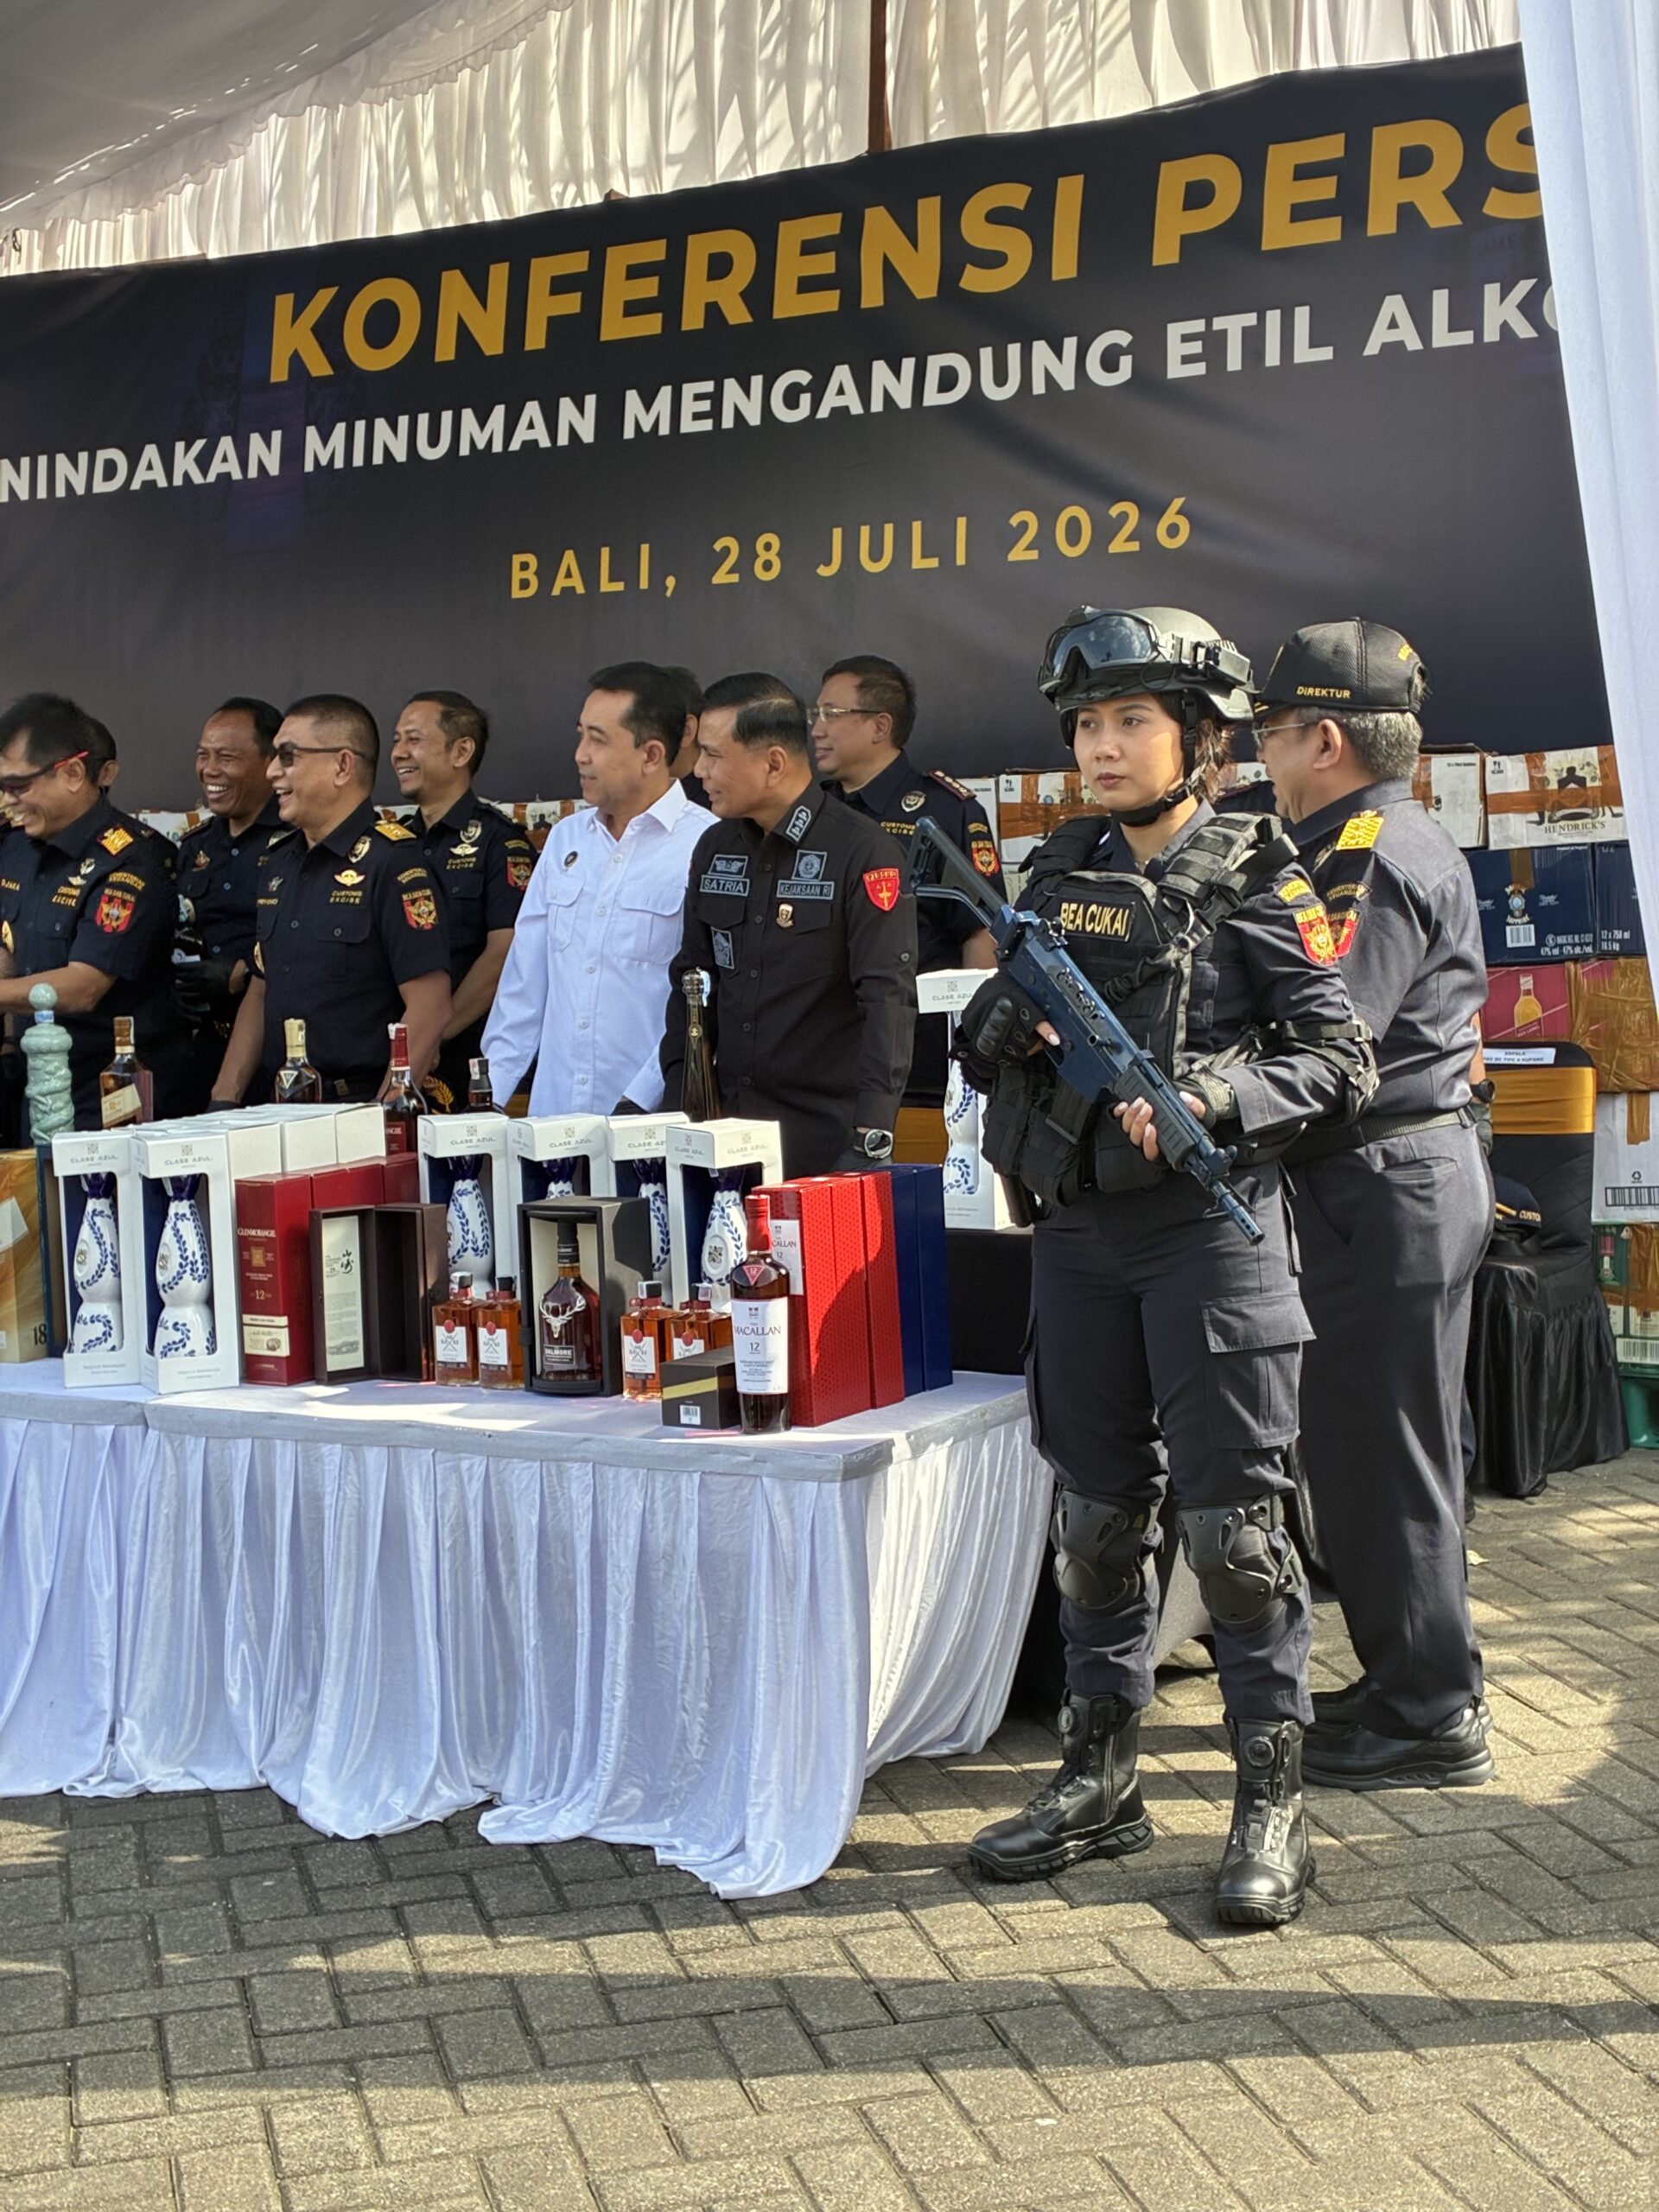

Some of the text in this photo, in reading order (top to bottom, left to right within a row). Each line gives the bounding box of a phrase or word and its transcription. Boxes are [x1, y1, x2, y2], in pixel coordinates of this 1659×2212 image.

[270, 102, 1543, 383] KONFERENSI PERS
[0, 429, 283, 503] NINDAKAN
[303, 393, 597, 473] MINUMAN
[623, 329, 1134, 440] MENGANDUNG
[1166, 305, 1334, 380] ETIL
[511, 496, 1191, 600] BALI, 28 JULI 2026
[1296, 685, 1351, 699] DIREKTUR
[1544, 820, 1606, 834] HENDRICK'S
[703, 879, 745, 893] SATRIA
[779, 884, 831, 897] KEJAKSAAN RI
[1059, 902, 1129, 937] BEA CUKAI
[238, 1227, 276, 1238] GLENMORANGIE
[255, 1289, 265, 1300] 12
[33, 1323, 48, 1346] 18
[734, 1325, 781, 1336] MACALLAN
[749, 1341, 760, 1352] 12
